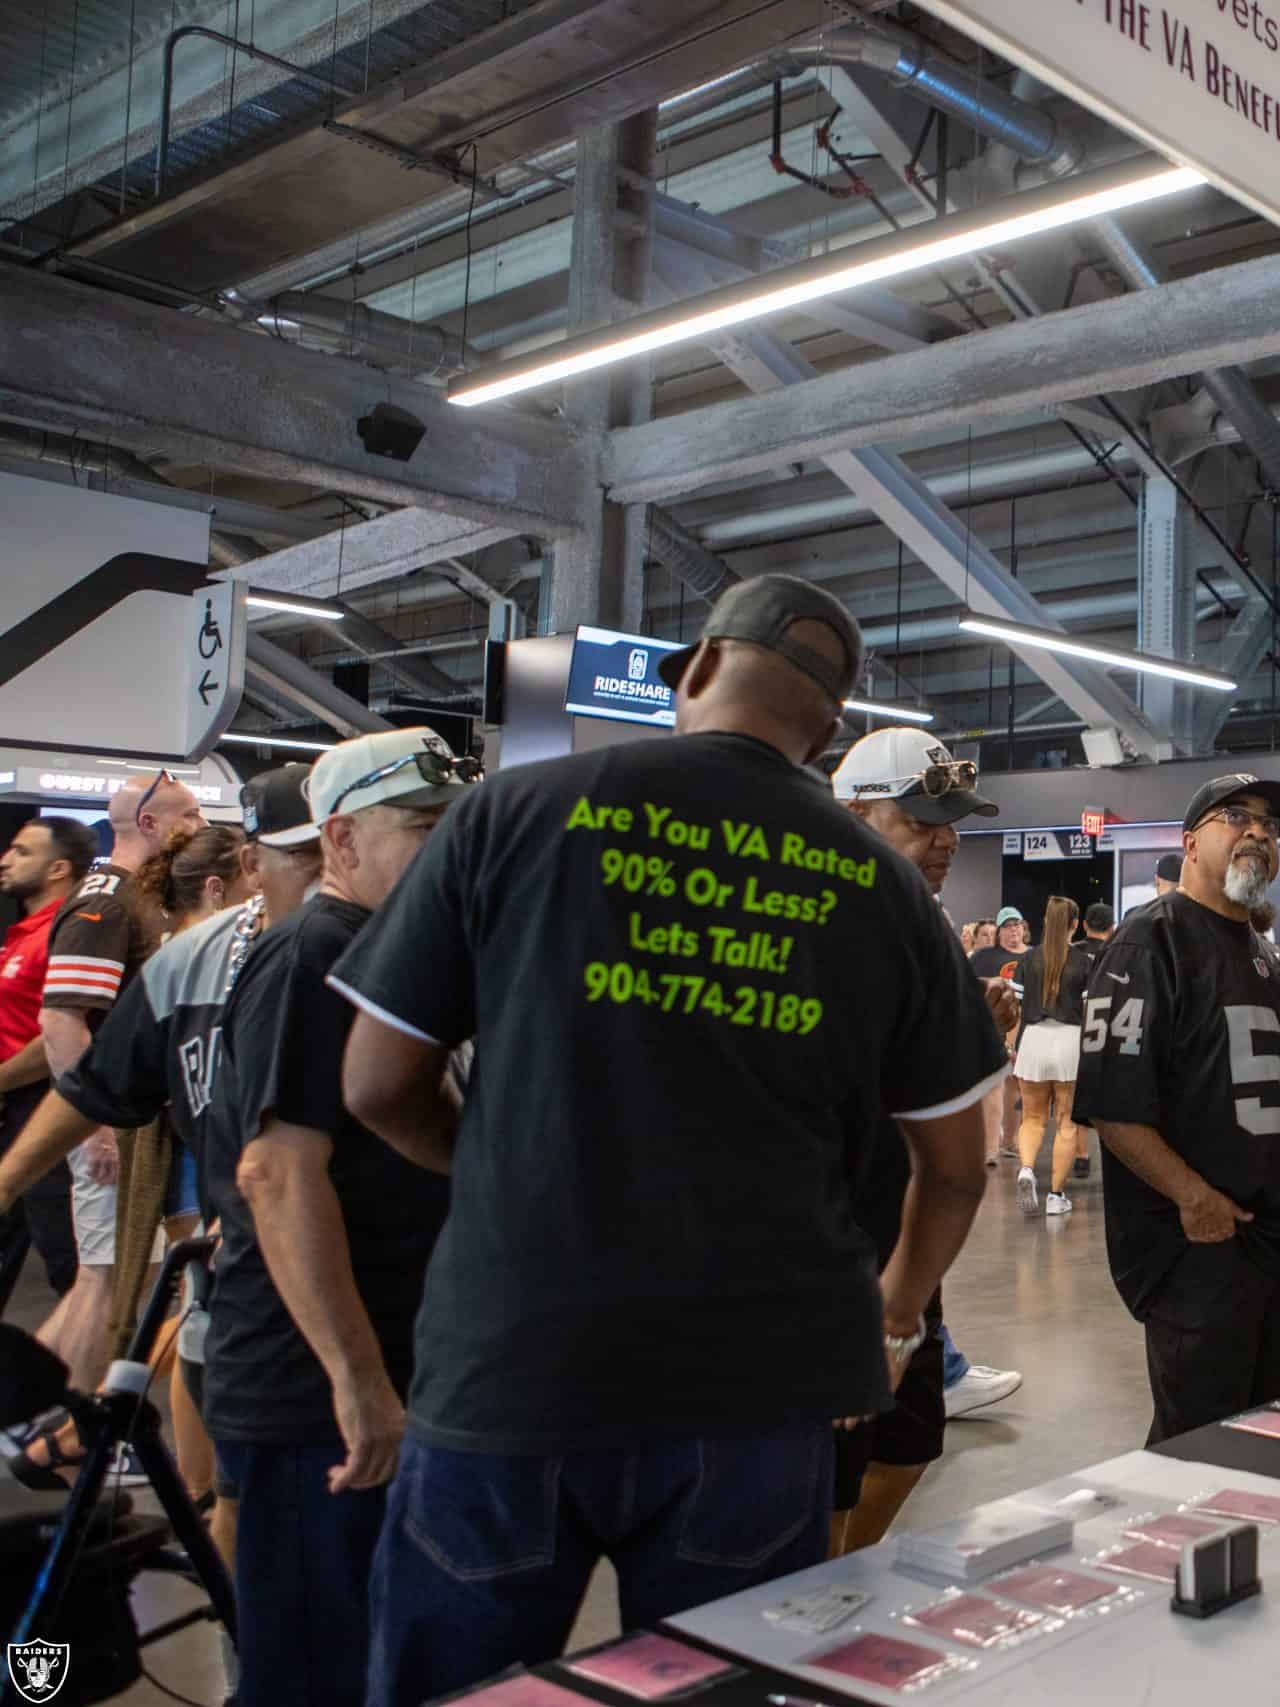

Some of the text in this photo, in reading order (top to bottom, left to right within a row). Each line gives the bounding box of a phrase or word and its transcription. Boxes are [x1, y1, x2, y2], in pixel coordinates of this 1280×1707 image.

[1161, 9, 1195, 82] VA
[594, 675, 672, 701] RIDESHARE
[566, 796, 877, 888] Are You VA Rated
[1026, 836, 1047, 849] 124
[1069, 833, 1091, 848] 123
[77, 873, 121, 898] 21
[601, 848, 838, 925] 90% Or Less?
[630, 911, 794, 974] Lets Talk!
[1082, 996, 1144, 1055] 54
